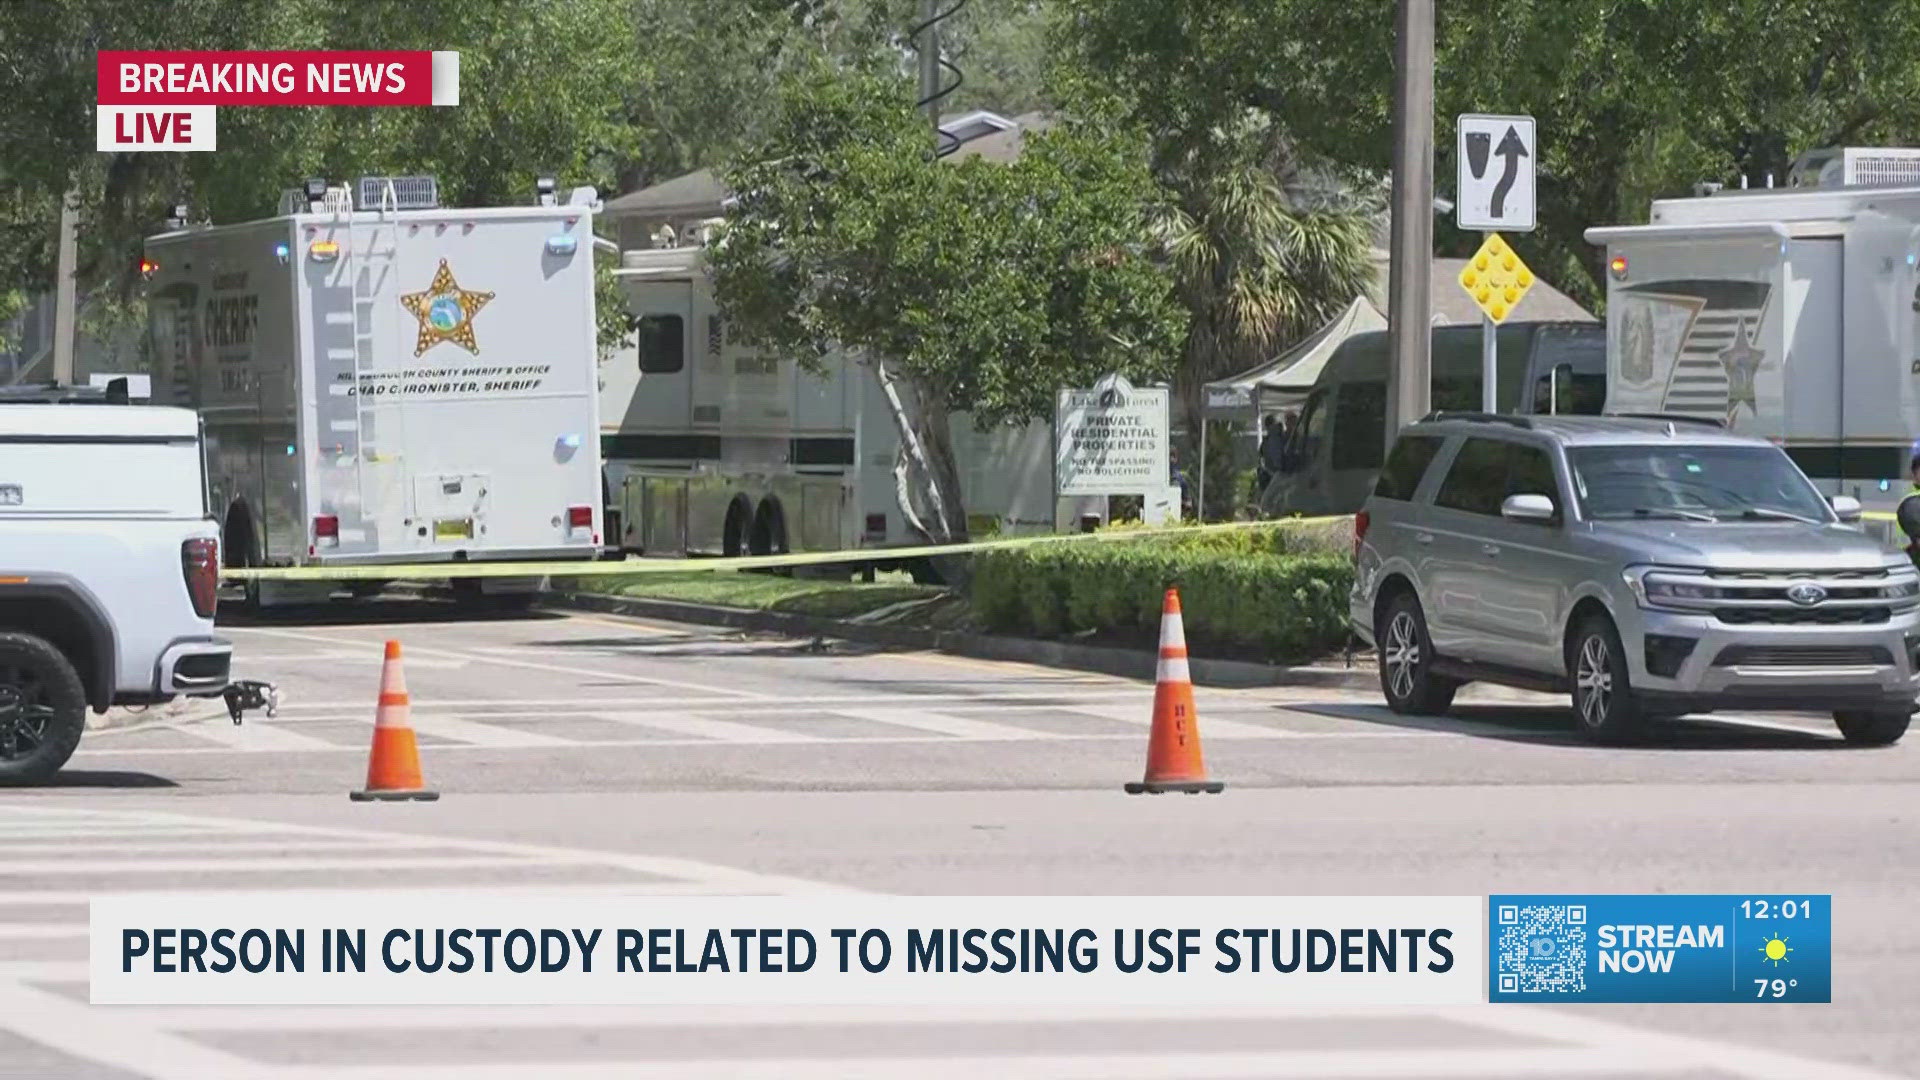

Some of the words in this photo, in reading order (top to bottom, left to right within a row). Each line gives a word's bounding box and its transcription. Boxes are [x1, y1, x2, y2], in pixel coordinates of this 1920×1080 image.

[417, 367, 459, 378] COUNTY
[461, 365, 512, 377] SHERIFF'S
[514, 364, 550, 375] OFFICE
[347, 384, 386, 397] CHAD
[484, 378, 543, 392] SHERIFF
[1086, 415, 1142, 426] PRIVATE
[1071, 428, 1158, 438] RESIDENTIAL
[1073, 439, 1156, 450] PROPERTIES
[1094, 467, 1151, 476] SOLICITING
